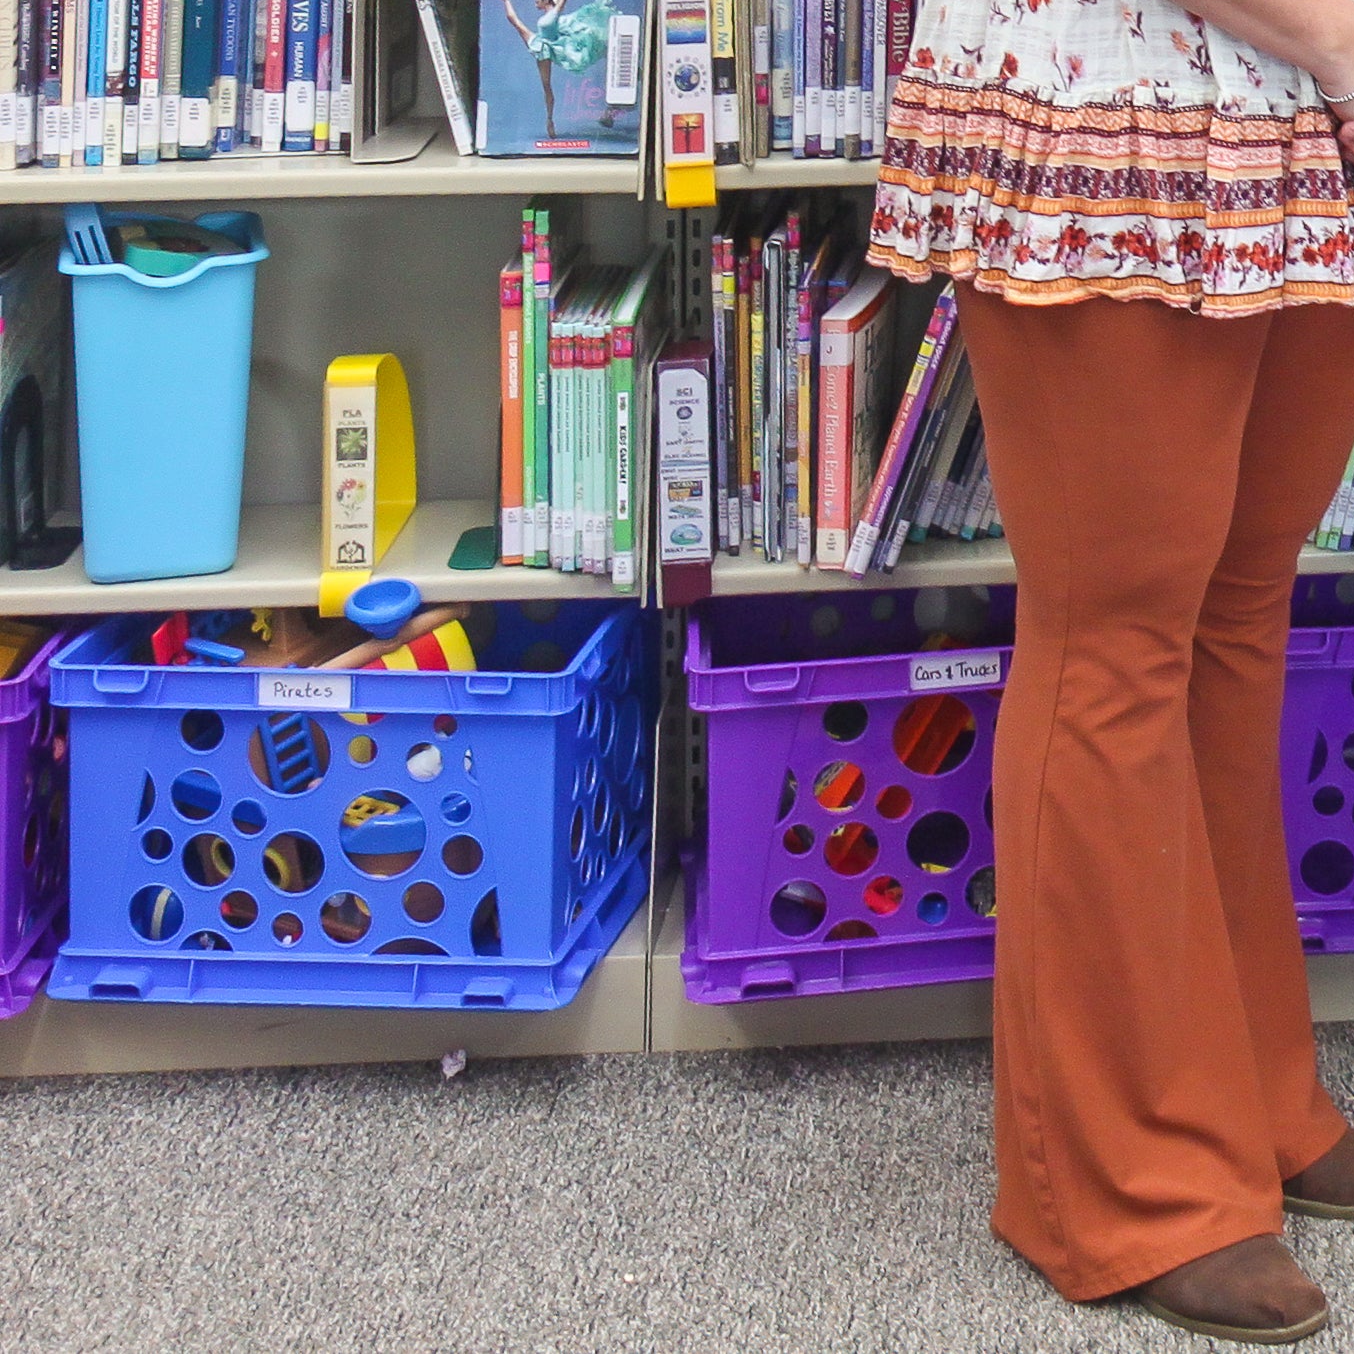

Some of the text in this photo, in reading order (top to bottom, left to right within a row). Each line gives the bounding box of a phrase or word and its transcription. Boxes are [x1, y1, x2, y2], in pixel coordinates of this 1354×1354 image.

[225, 19, 236, 61] TYCOONS
[718, 33, 729, 52] Me
[892, 12, 910, 63] Bible
[294, 41, 304, 77] HUMAN
[536, 373, 546, 405] PLANTS
[675, 388, 694, 397] SCI
[342, 409, 362, 419] PLA
[824, 414, 840, 456] Planet
[824, 460, 840, 497] Earth
[915, 666, 942, 680] Cars
[273, 681, 333, 698] Pirates
